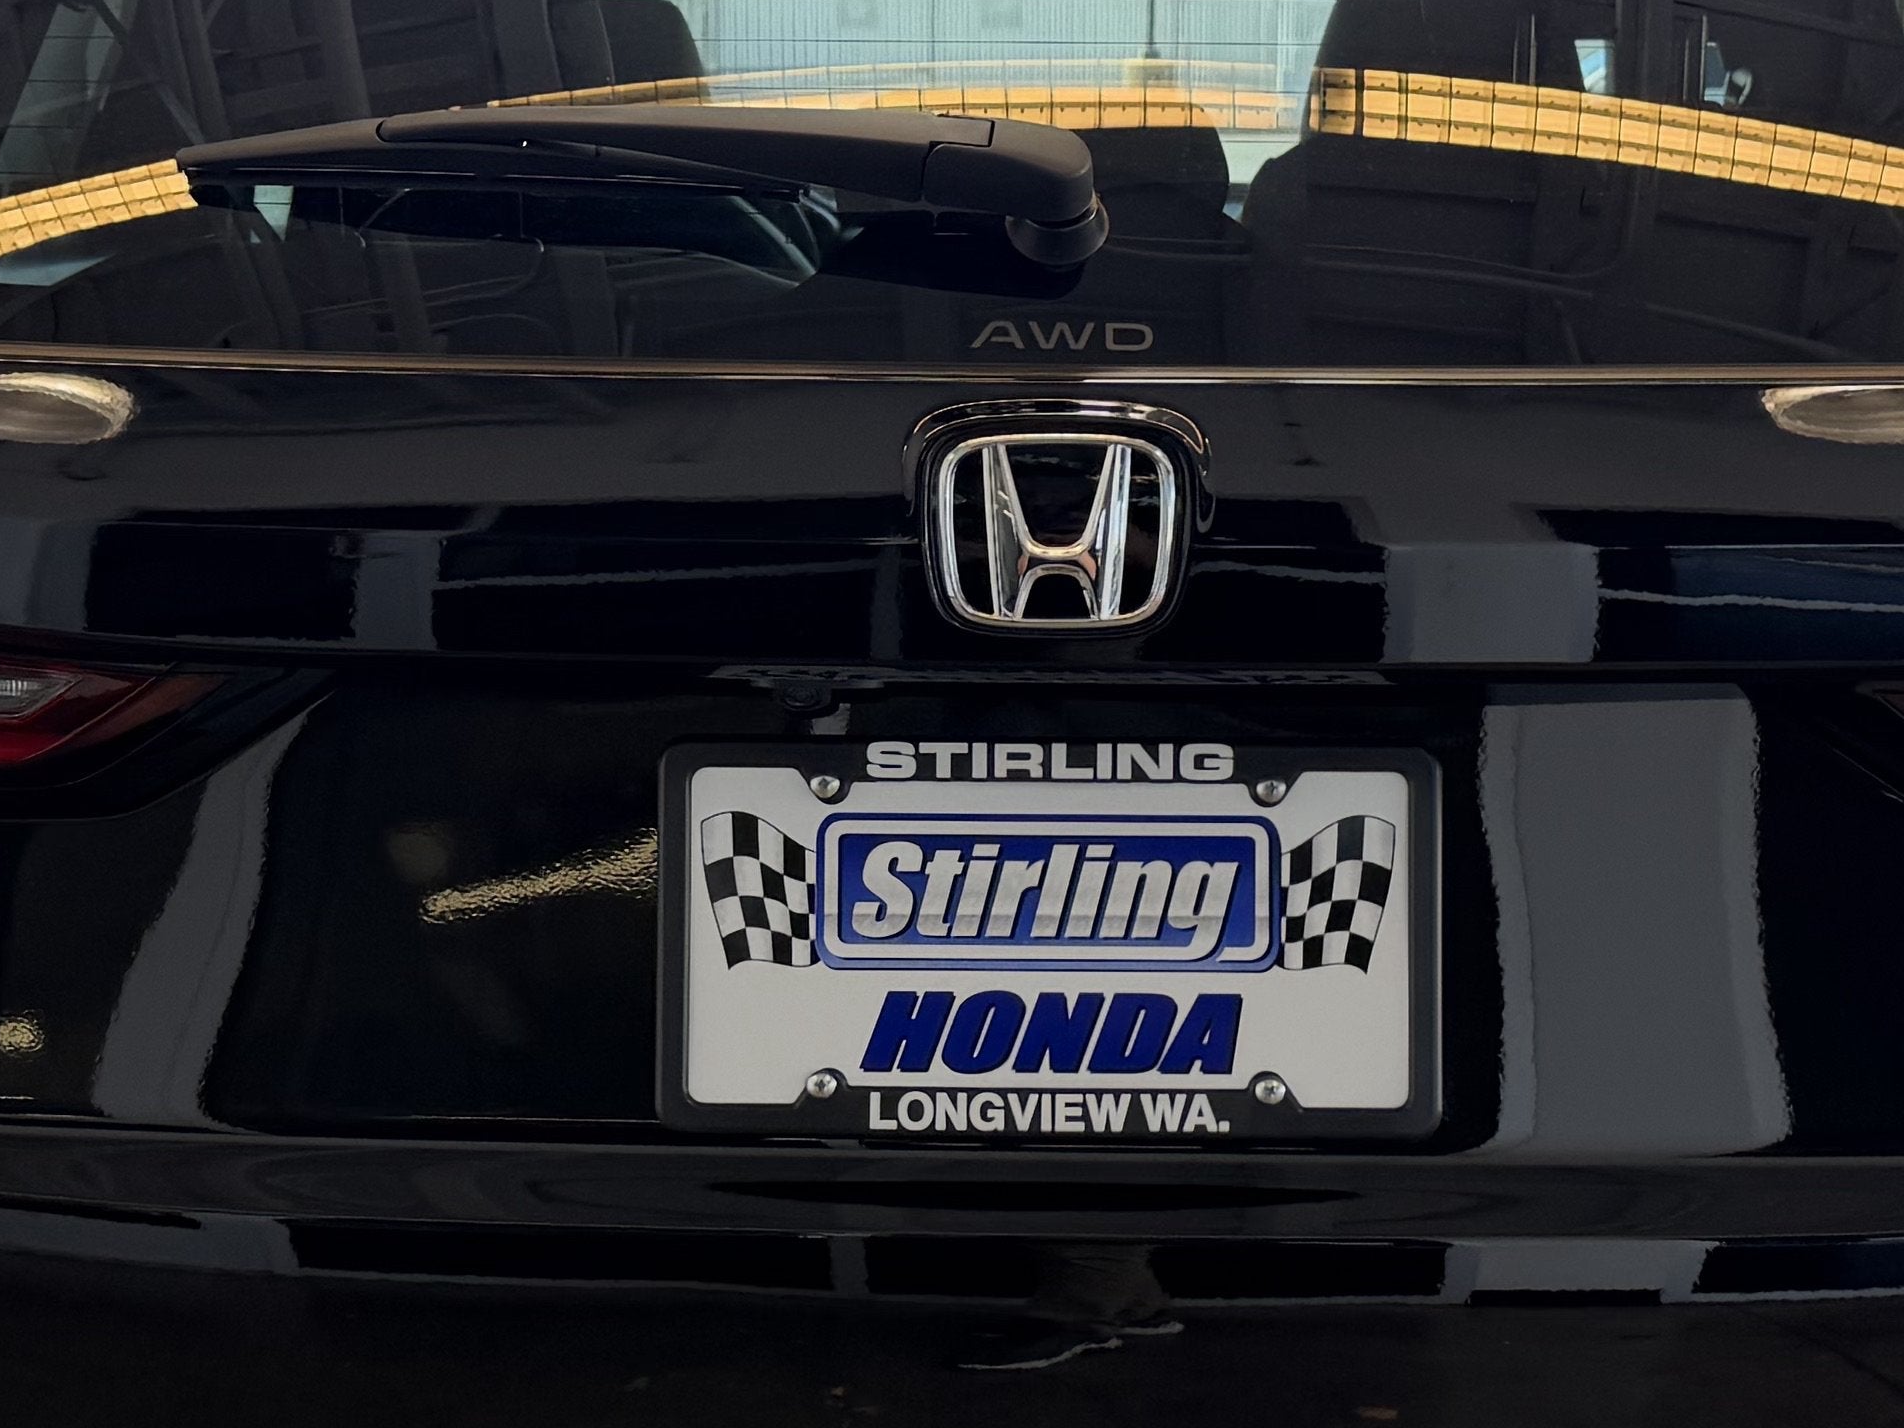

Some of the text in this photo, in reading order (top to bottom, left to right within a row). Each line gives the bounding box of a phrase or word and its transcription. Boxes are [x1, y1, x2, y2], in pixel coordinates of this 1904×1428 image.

[969, 320, 1154, 351] AWD
[866, 741, 1235, 781] STIRLING
[850, 840, 1243, 961] Stirling
[860, 990, 1244, 1075] HONDA
[868, 1092, 1231, 1132] LONGVIEW WA.
